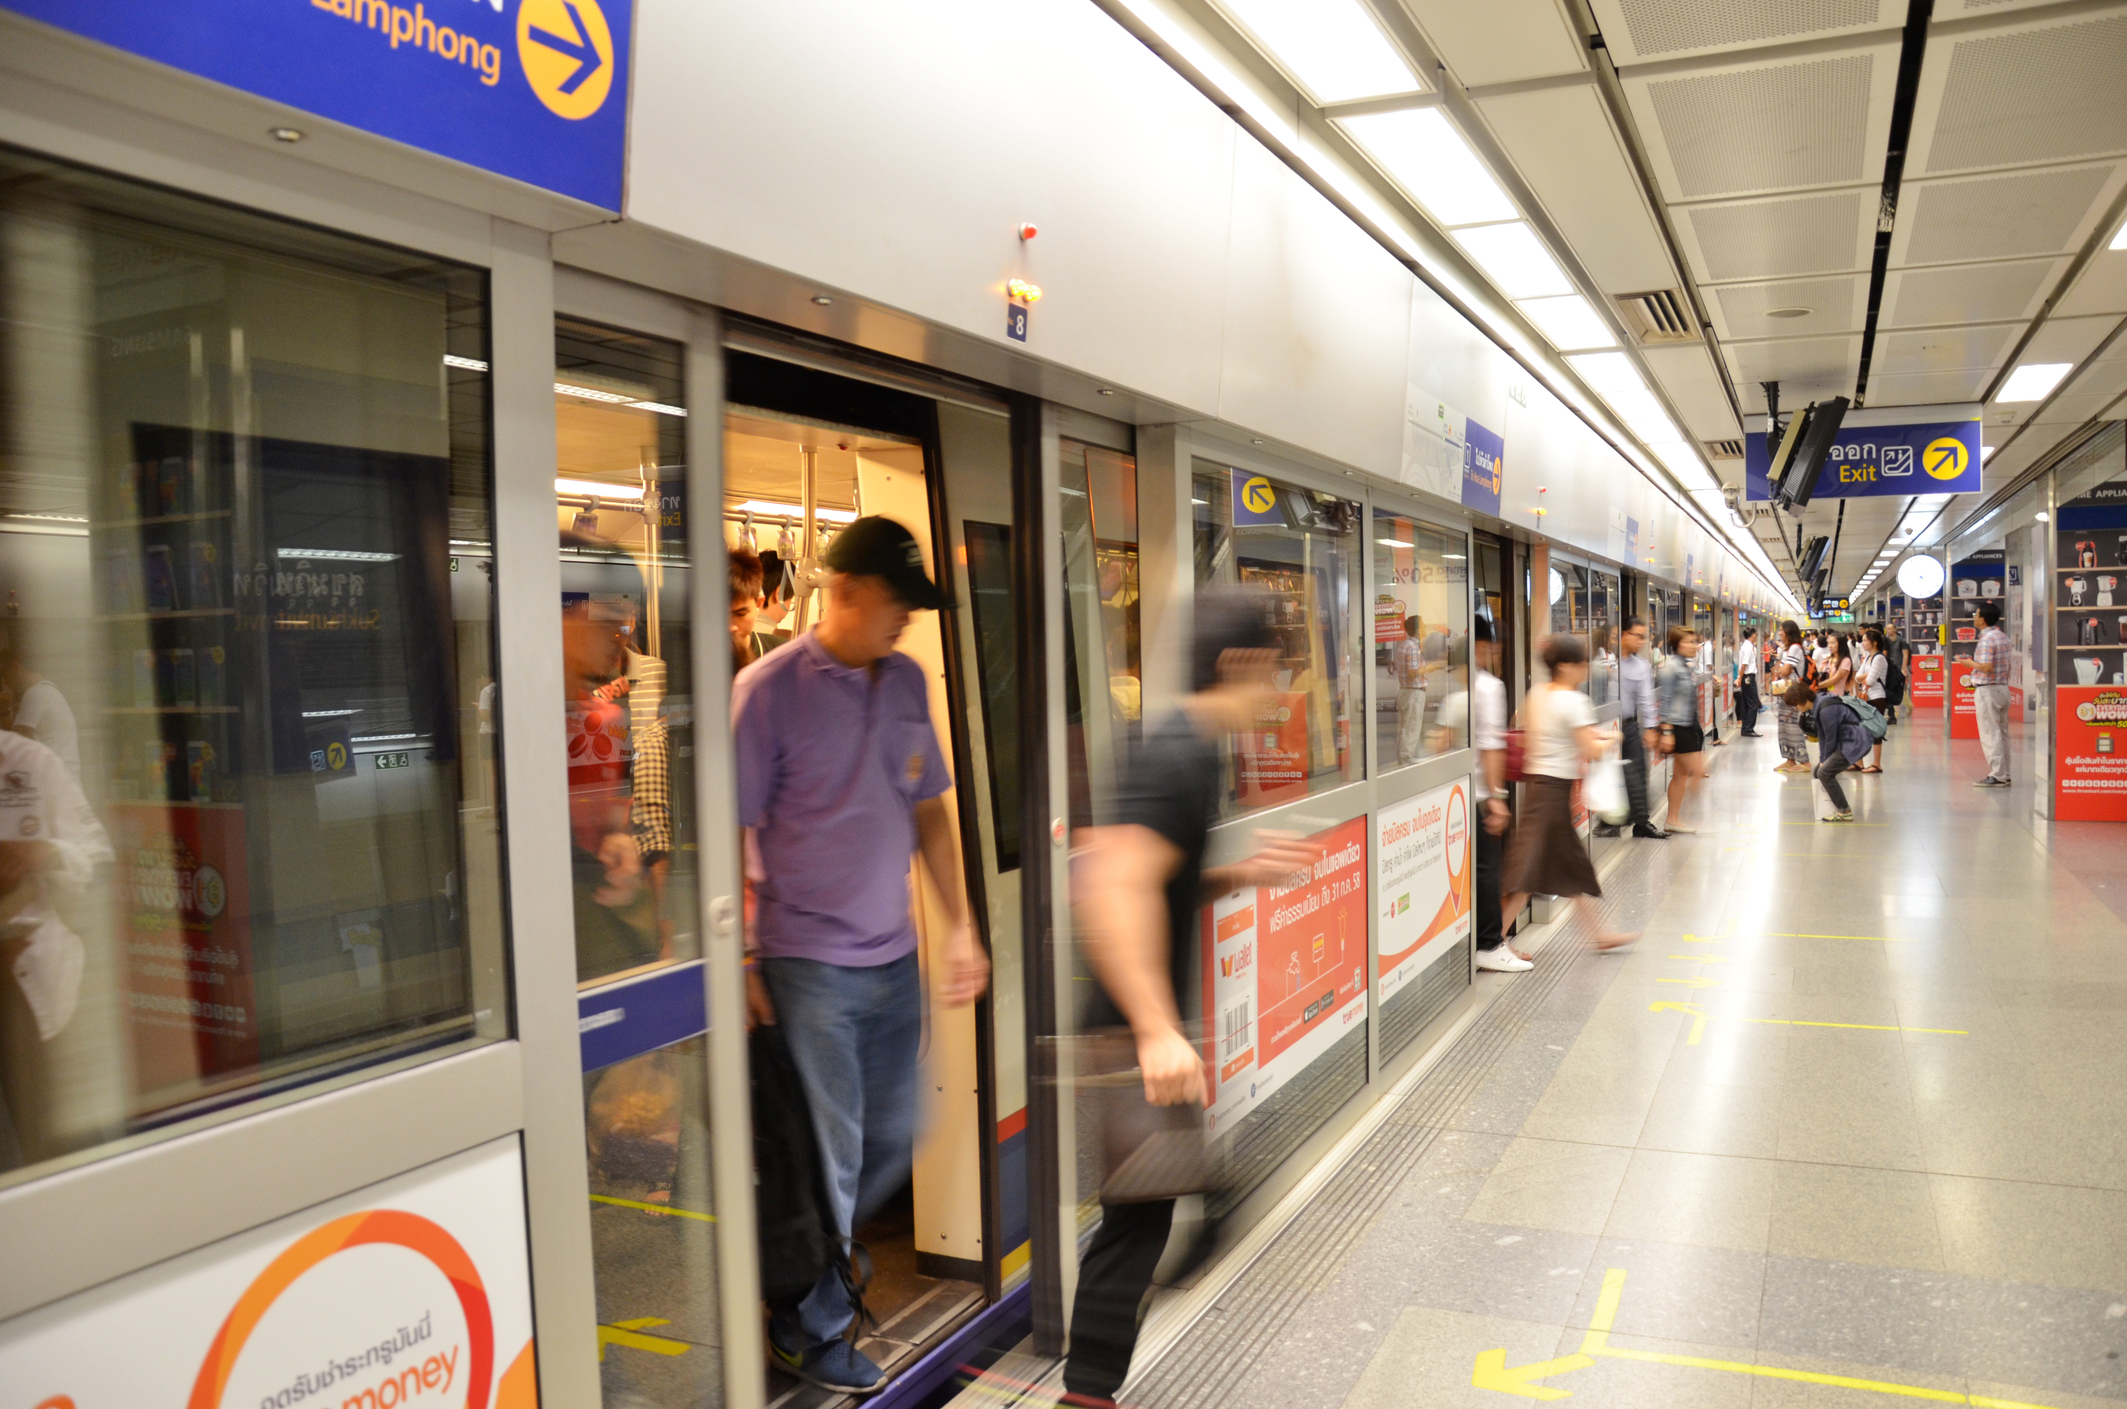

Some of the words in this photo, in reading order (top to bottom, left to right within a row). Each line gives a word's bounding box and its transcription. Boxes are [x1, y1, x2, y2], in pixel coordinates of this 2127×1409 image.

[311, 0, 501, 86] amphong
[1015, 314, 1025, 336] 8
[1829, 443, 1877, 461] ออก
[1839, 463, 1877, 483] Exit
[1332, 881, 1339, 902] 31
[1353, 871, 1361, 890] 58
[320, 1344, 458, 1409] money
